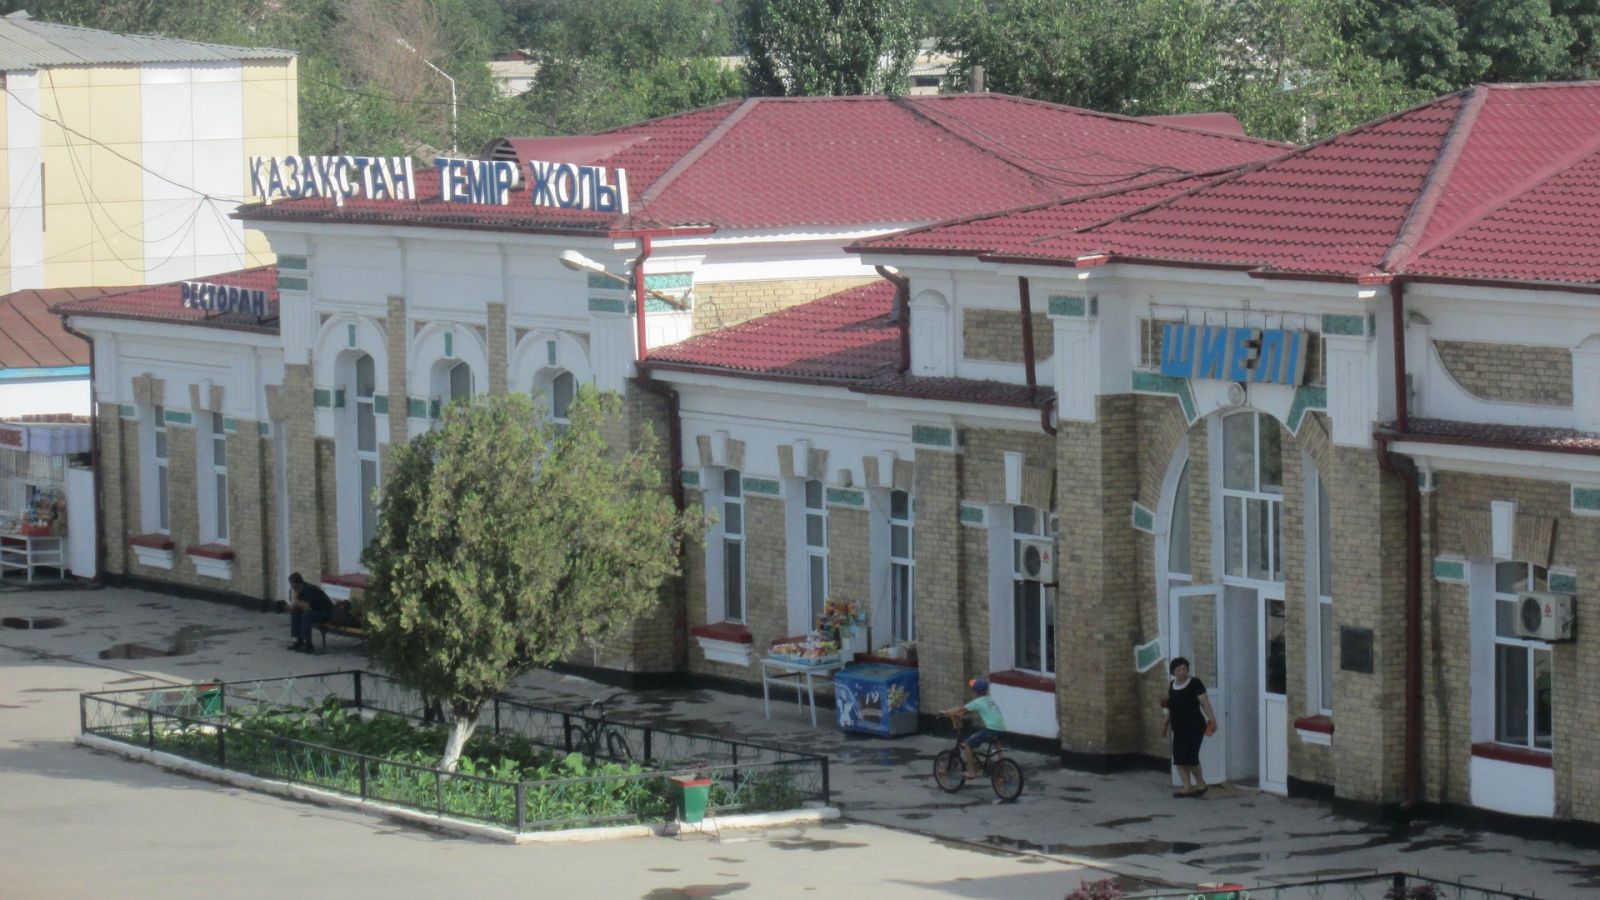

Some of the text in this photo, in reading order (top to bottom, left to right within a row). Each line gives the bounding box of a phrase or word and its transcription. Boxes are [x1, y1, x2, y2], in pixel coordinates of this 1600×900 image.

[249, 155, 629, 214] ҚАЗАҚСТАН ТЕМІР ЖОЛЫ
[180, 281, 269, 316] РЕСТОРАН
[1160, 323, 1308, 386] ШИЕЛІ
